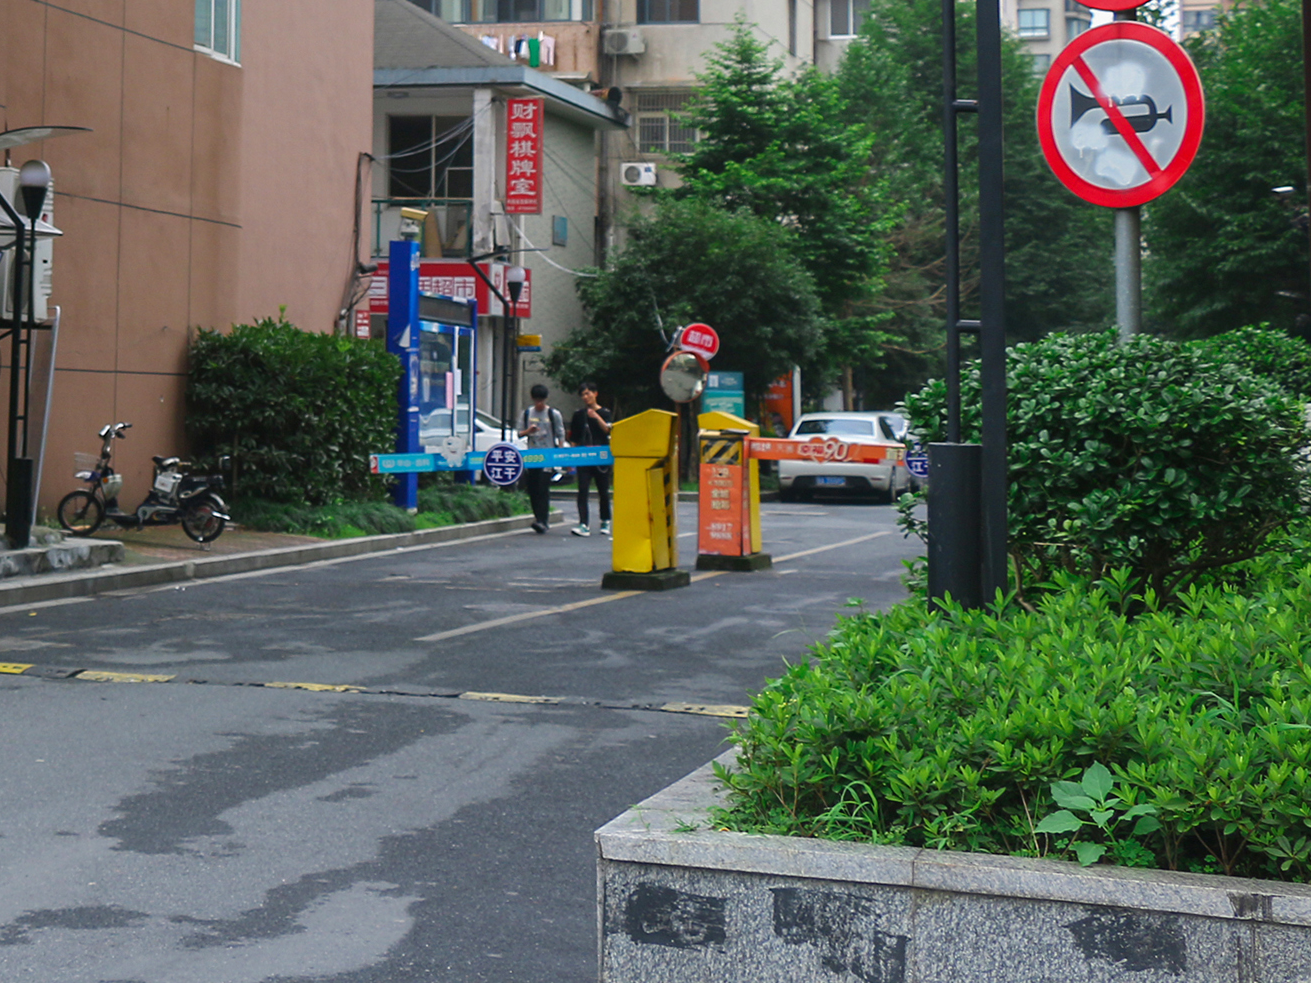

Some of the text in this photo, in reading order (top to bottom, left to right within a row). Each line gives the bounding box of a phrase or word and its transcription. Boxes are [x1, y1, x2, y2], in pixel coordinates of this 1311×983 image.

[510, 103, 538, 196] 财飘棋牌室
[490, 450, 517, 463] 平安
[490, 467, 517, 480] 江干
